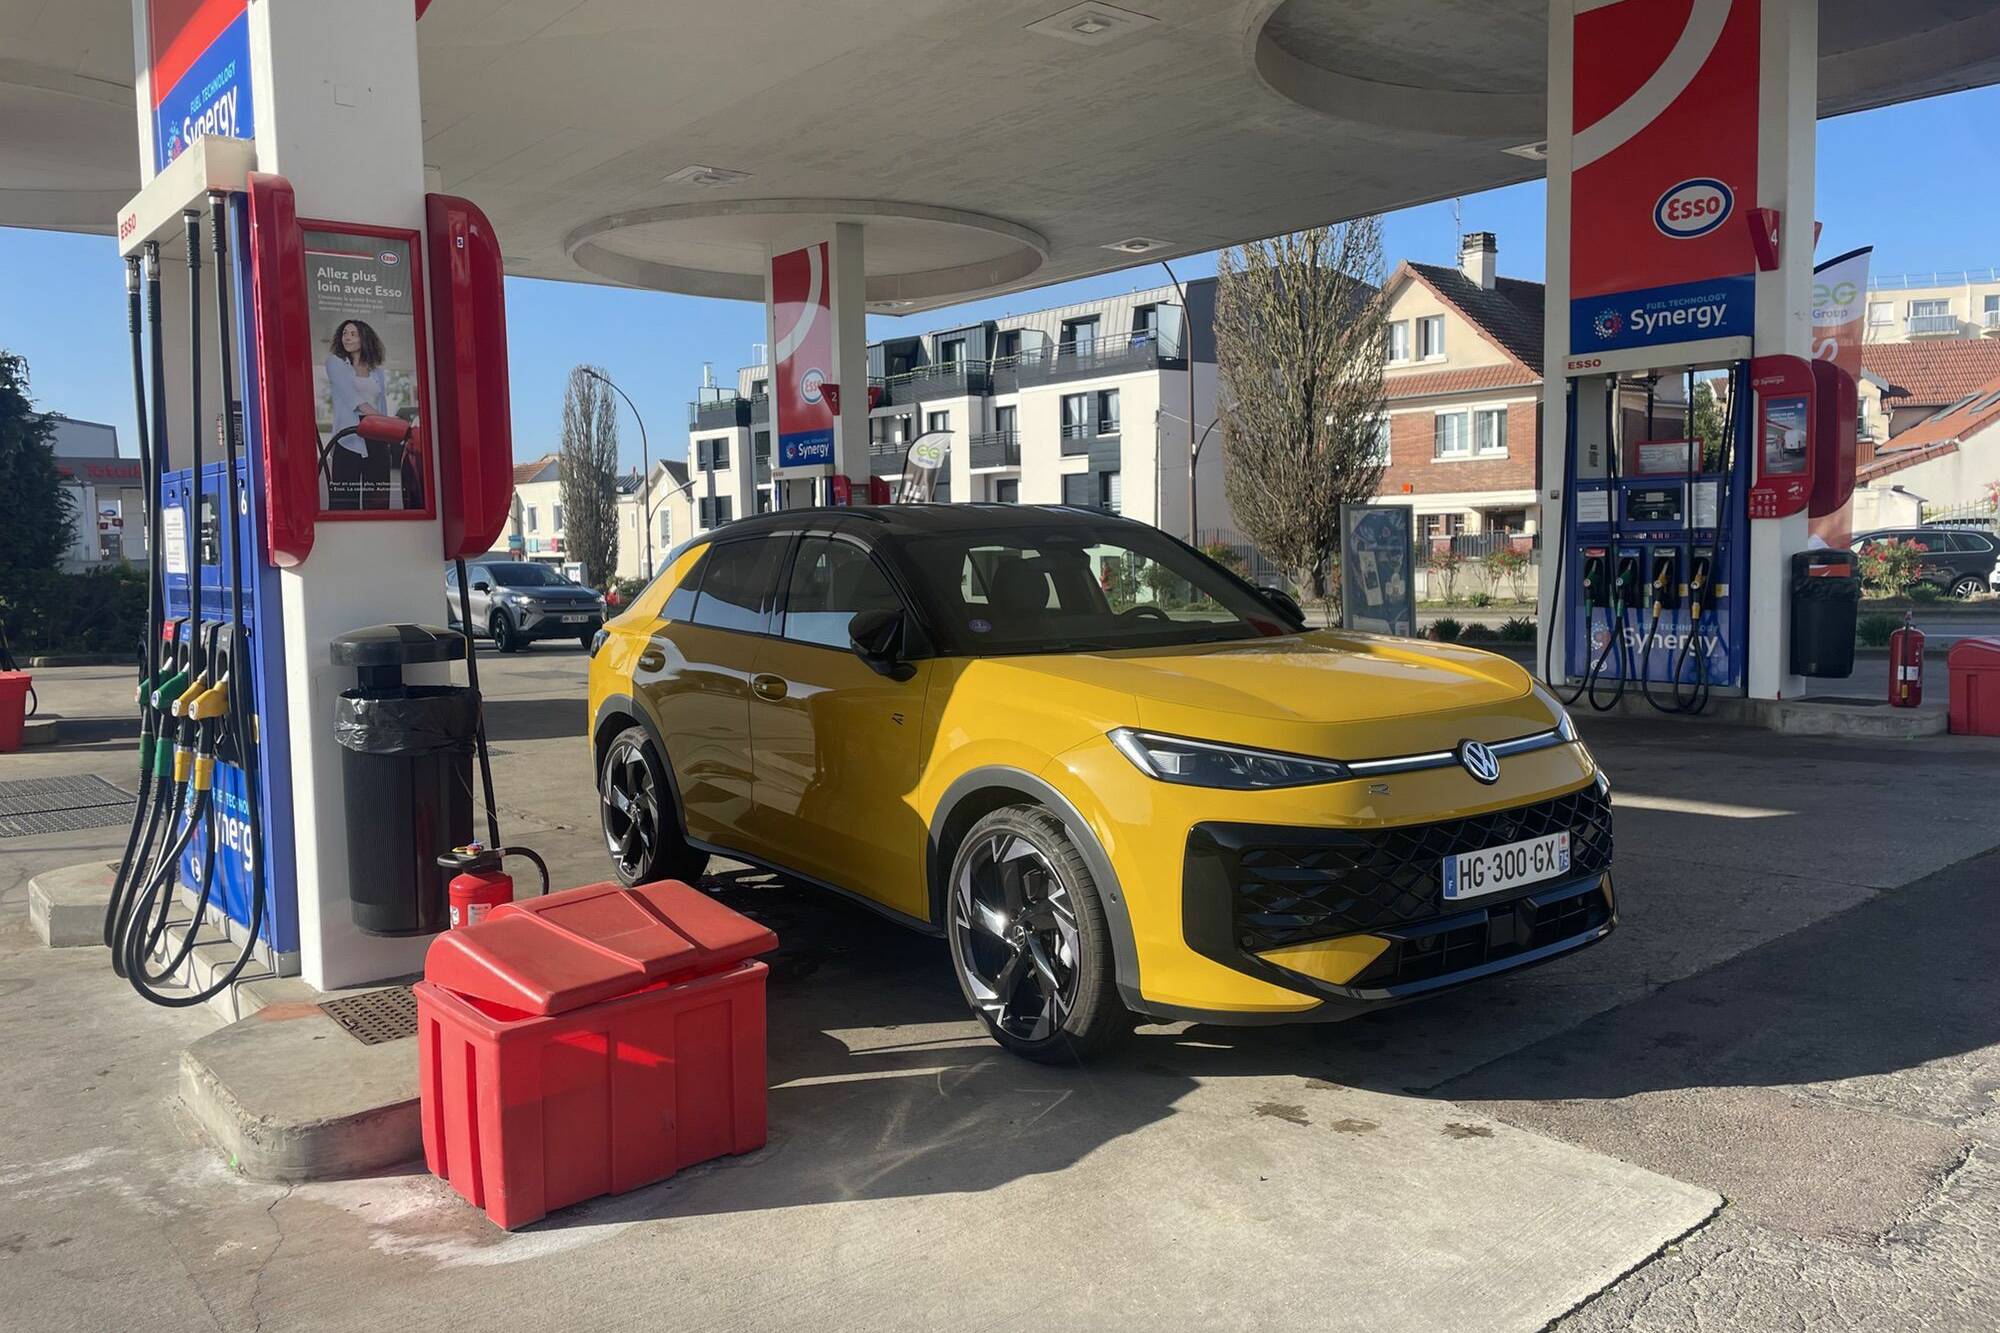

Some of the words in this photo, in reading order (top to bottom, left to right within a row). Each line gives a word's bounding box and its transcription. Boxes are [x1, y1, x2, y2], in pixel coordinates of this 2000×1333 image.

[190, 94, 202, 114] FUEL
[202, 59, 237, 102] TECHNOLOGY
[1666, 196, 1722, 222] Esso
[120, 213, 136, 240] ESSO
[1770, 229, 1778, 246] 4
[316, 266, 349, 280] Allez
[352, 270, 377, 283] plus
[317, 280, 341, 293] loin
[344, 285, 372, 295] avec
[375, 285, 402, 298] Esso
[1646, 302, 1666, 310] FUEL
[1669, 293, 1727, 307] TECHNOLOGY
[1630, 304, 1727, 335] Synergy
[1812, 308, 1848, 319] Group
[1567, 359, 1602, 370] ESSO
[831, 391, 838, 401] 2
[798, 443, 830, 459] Synergy
[241, 490, 248, 516] 6
